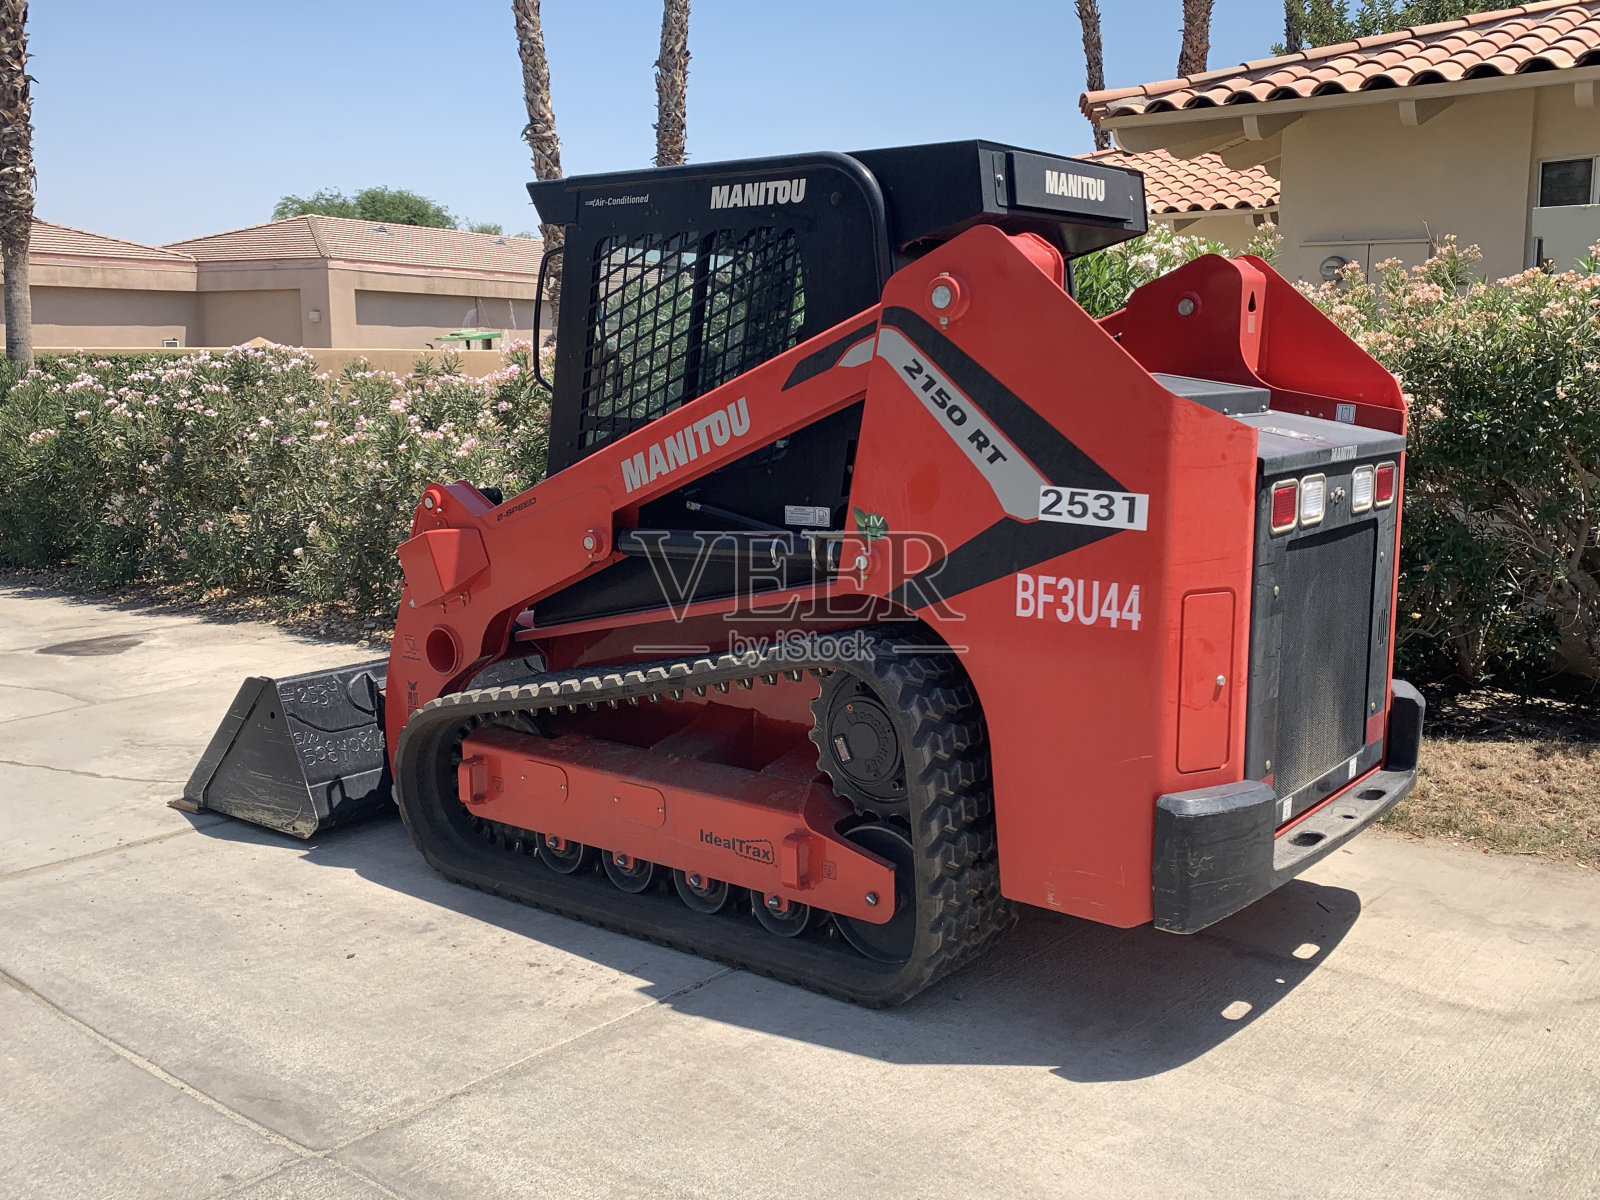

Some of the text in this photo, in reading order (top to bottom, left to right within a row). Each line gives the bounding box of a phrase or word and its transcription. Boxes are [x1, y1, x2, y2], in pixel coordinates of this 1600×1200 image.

[594, 193, 650, 207] Air-Conditioned
[710, 178, 807, 210] MANITOU
[1045, 169, 1105, 202] MANITOU
[902, 358, 1008, 466] 2150 RT
[620, 396, 751, 494] MANITOU
[1330, 444, 1358, 462] MANITOU
[496, 496, 537, 522] 2-SPEED
[1040, 488, 1137, 524] 2531
[1015, 572, 1142, 631] BF3U44
[699, 828, 771, 862] IdealTrax
